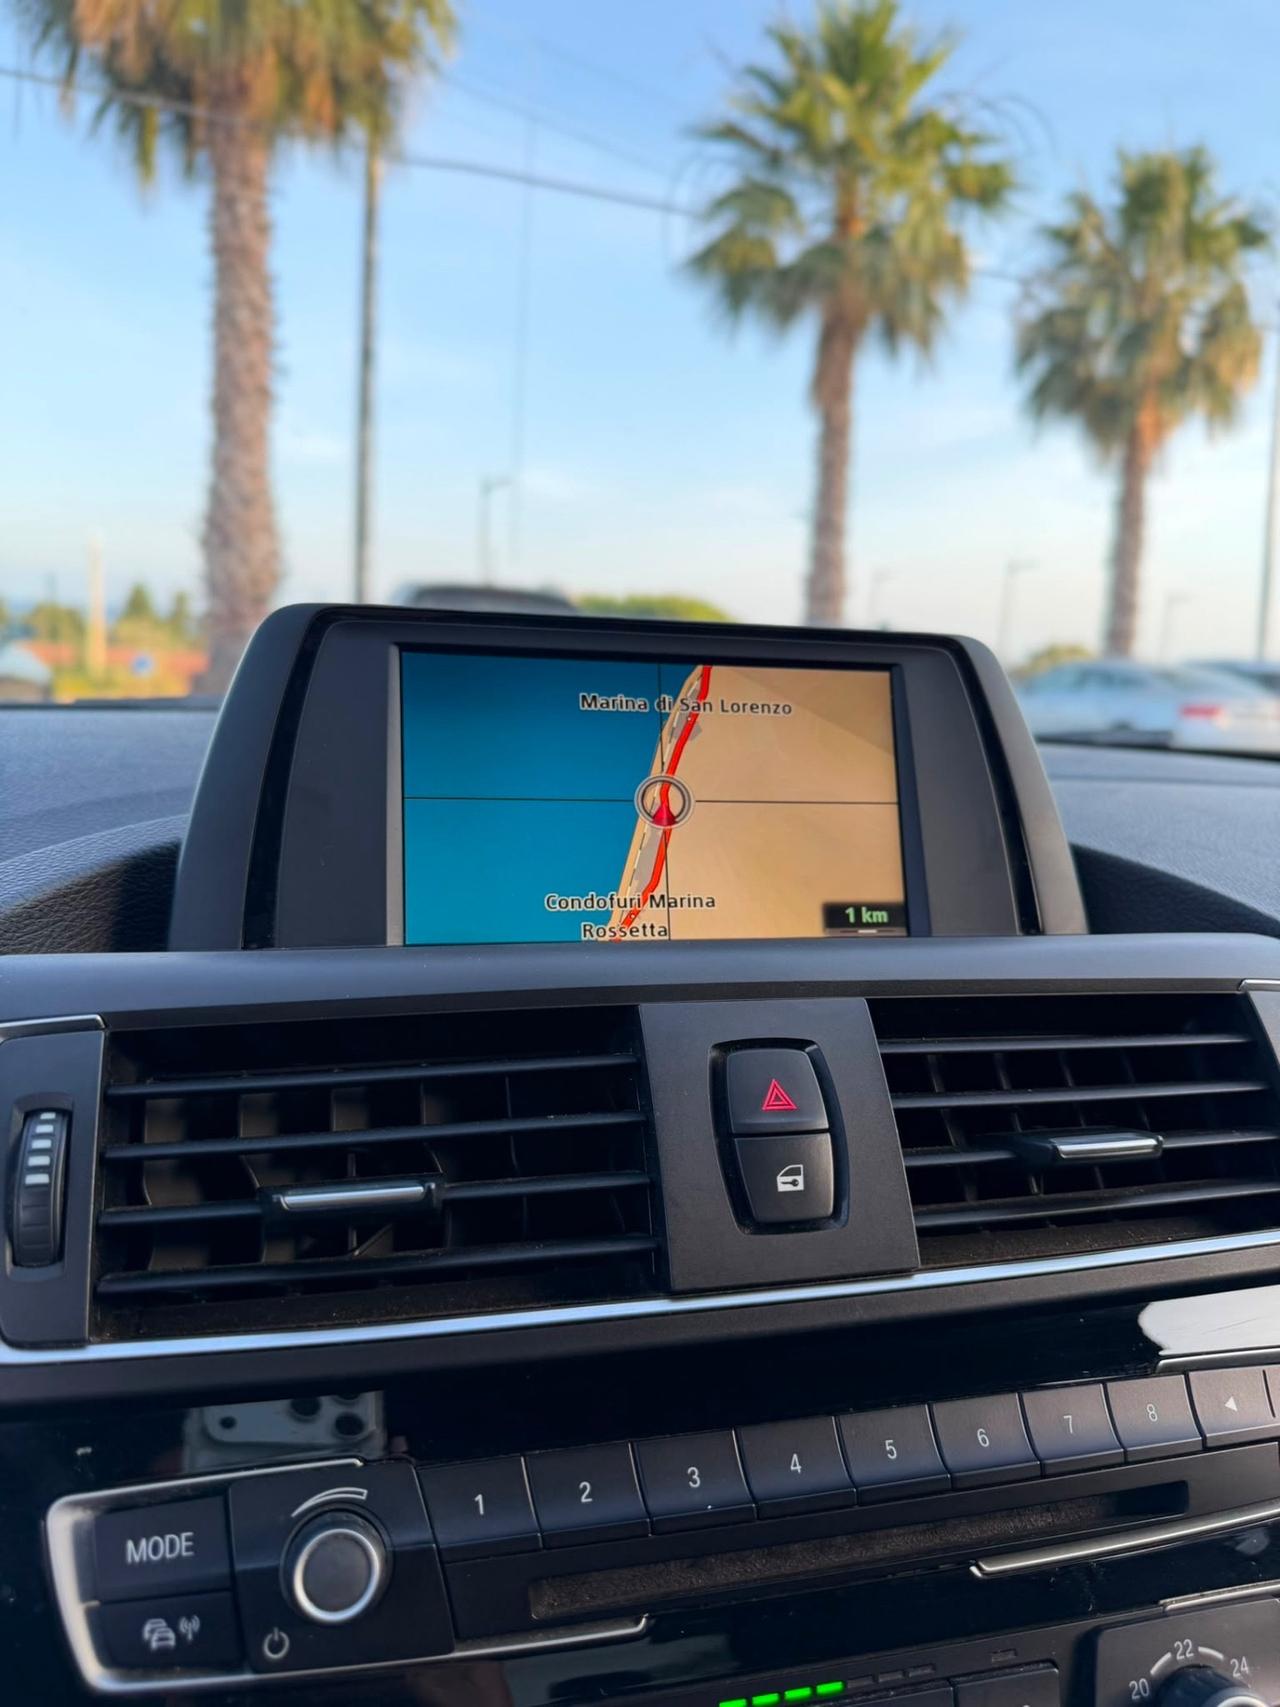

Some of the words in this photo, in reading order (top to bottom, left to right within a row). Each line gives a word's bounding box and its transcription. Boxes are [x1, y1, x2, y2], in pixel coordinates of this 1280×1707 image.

[579, 692, 648, 712] Marina
[656, 694, 674, 712] di
[679, 697, 713, 713] San
[720, 698, 792, 716] Lorenzo
[545, 893, 641, 910] Condofuri
[649, 894, 716, 910] Marina
[845, 907, 856, 923] 1
[861, 907, 888, 923] km
[582, 922, 669, 939] Rossetta
[1147, 1403, 1158, 1422] 8
[1063, 1415, 1074, 1434] 7
[977, 1428, 990, 1447] 6
[885, 1440, 898, 1460] 5
[790, 1453, 803, 1473] 4
[687, 1467, 701, 1488] 3
[579, 1482, 593, 1503] 2
[474, 1494, 485, 1515] 1
[126, 1532, 194, 1565] MODE
[1174, 1638, 1194, 1659] 22
[1230, 1656, 1249, 1677] 24
[1129, 1678, 1150, 1699] 20
